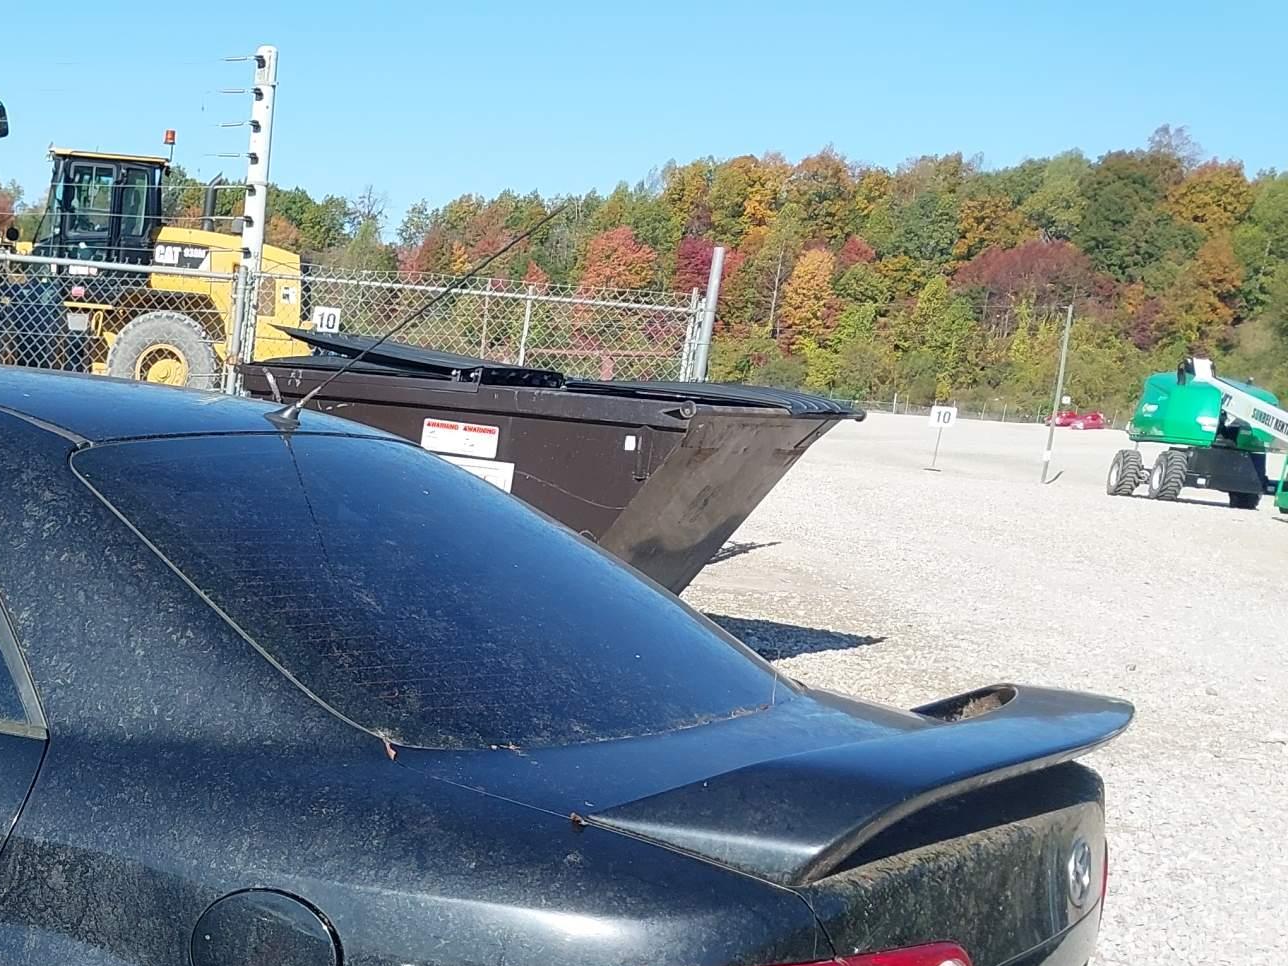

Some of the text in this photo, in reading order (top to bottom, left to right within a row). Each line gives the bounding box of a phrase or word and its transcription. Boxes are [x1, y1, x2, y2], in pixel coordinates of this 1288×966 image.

[154, 244, 182, 264] CAT
[318, 312, 336, 330] 10
[936, 410, 952, 424] 10
